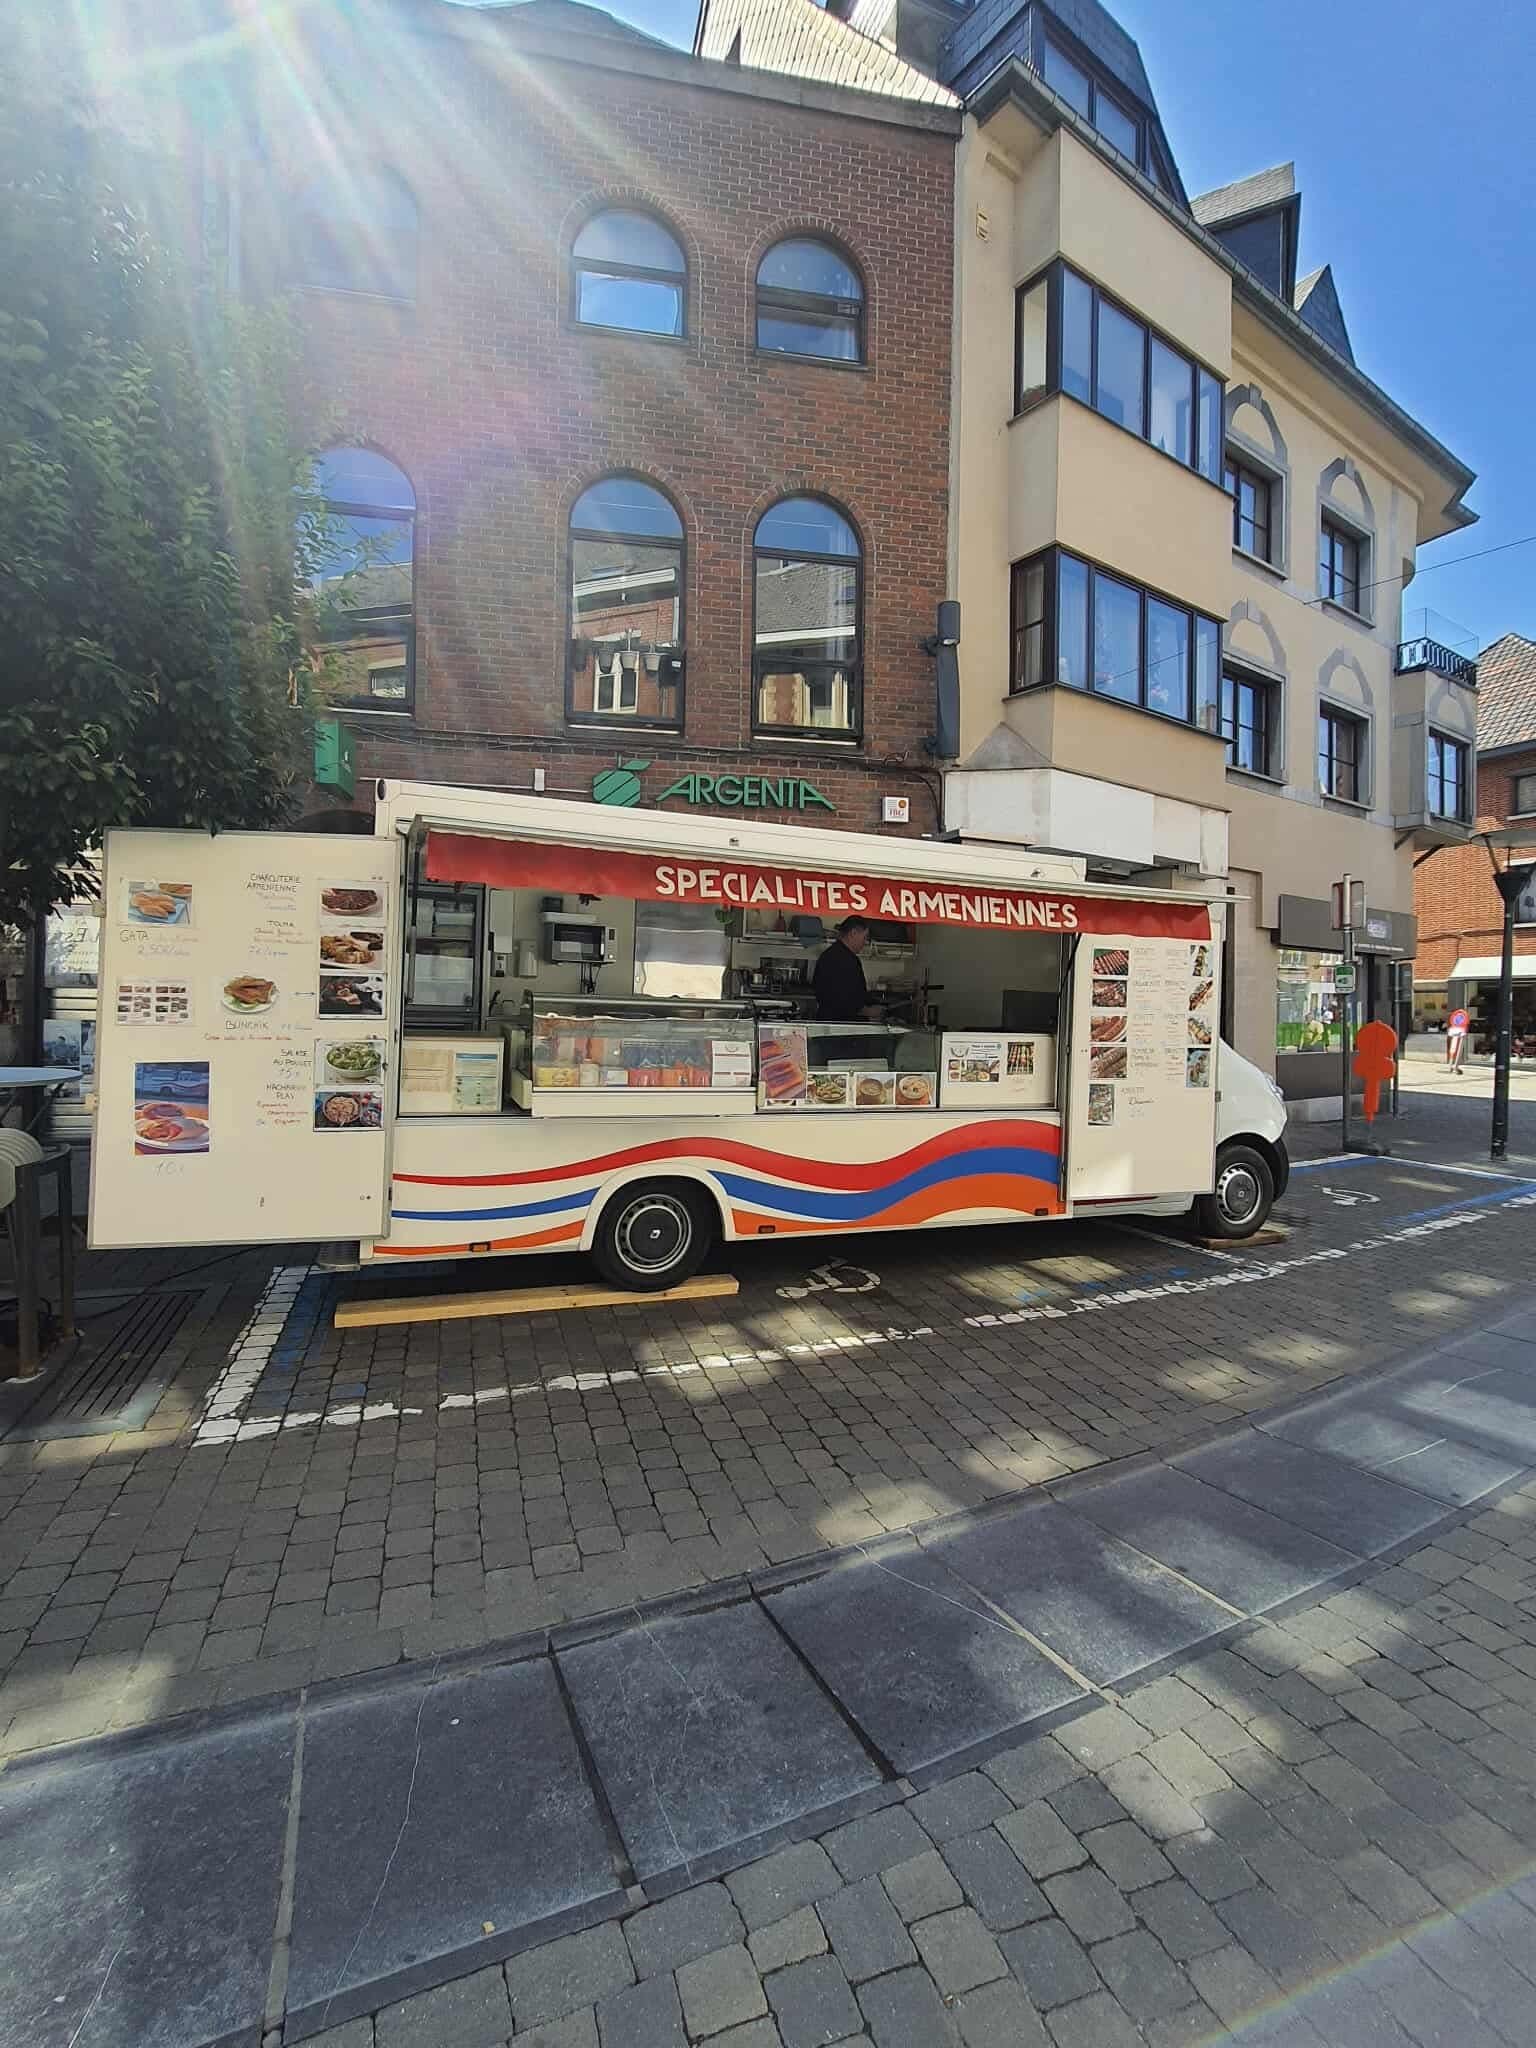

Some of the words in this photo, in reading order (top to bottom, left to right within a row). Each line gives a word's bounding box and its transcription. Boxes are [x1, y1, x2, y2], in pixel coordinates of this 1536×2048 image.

[656, 773, 837, 811] ARGENTA
[655, 865, 868, 912] SPECIALITES
[880, 889, 1078, 928] ARMENIENNES
[119, 929, 150, 942] GATA
